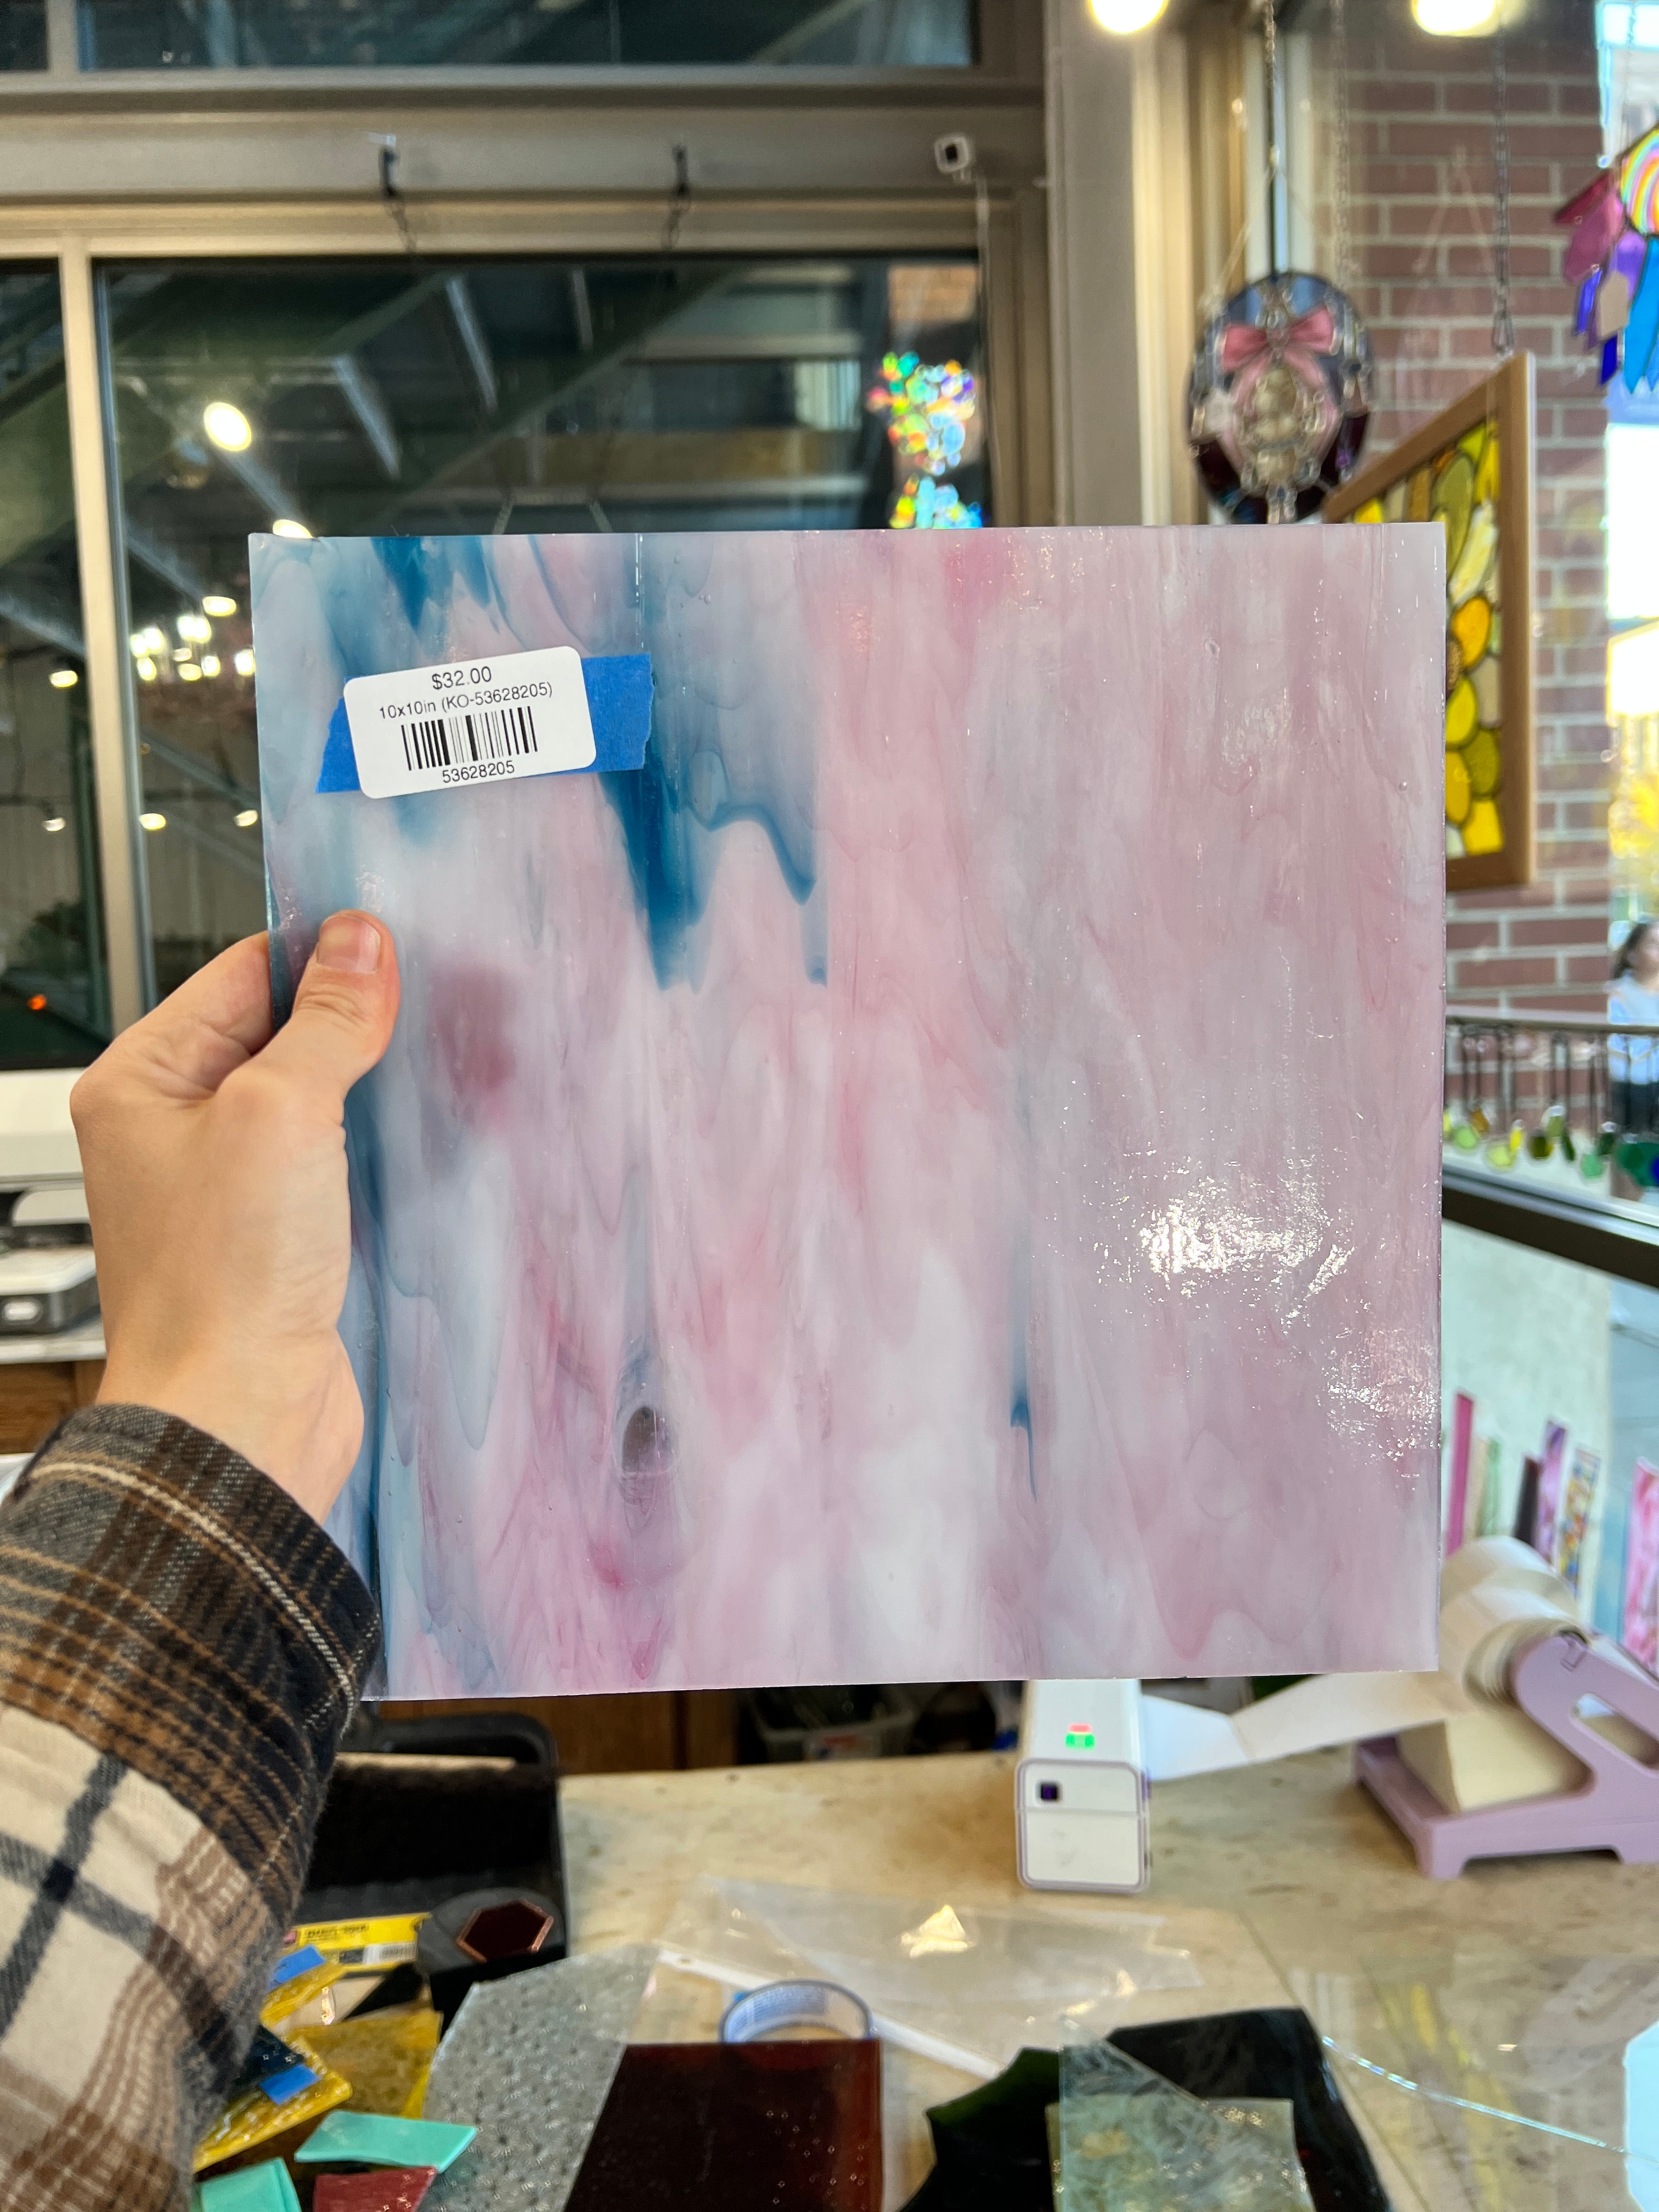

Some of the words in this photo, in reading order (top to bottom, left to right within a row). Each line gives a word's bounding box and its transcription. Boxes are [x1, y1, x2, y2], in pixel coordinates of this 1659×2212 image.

[432, 666, 492, 690] $32.00
[379, 701, 437, 719] 10x10in
[441, 681, 553, 712] (KO-53628205)
[442, 761, 515, 783] 53628205
